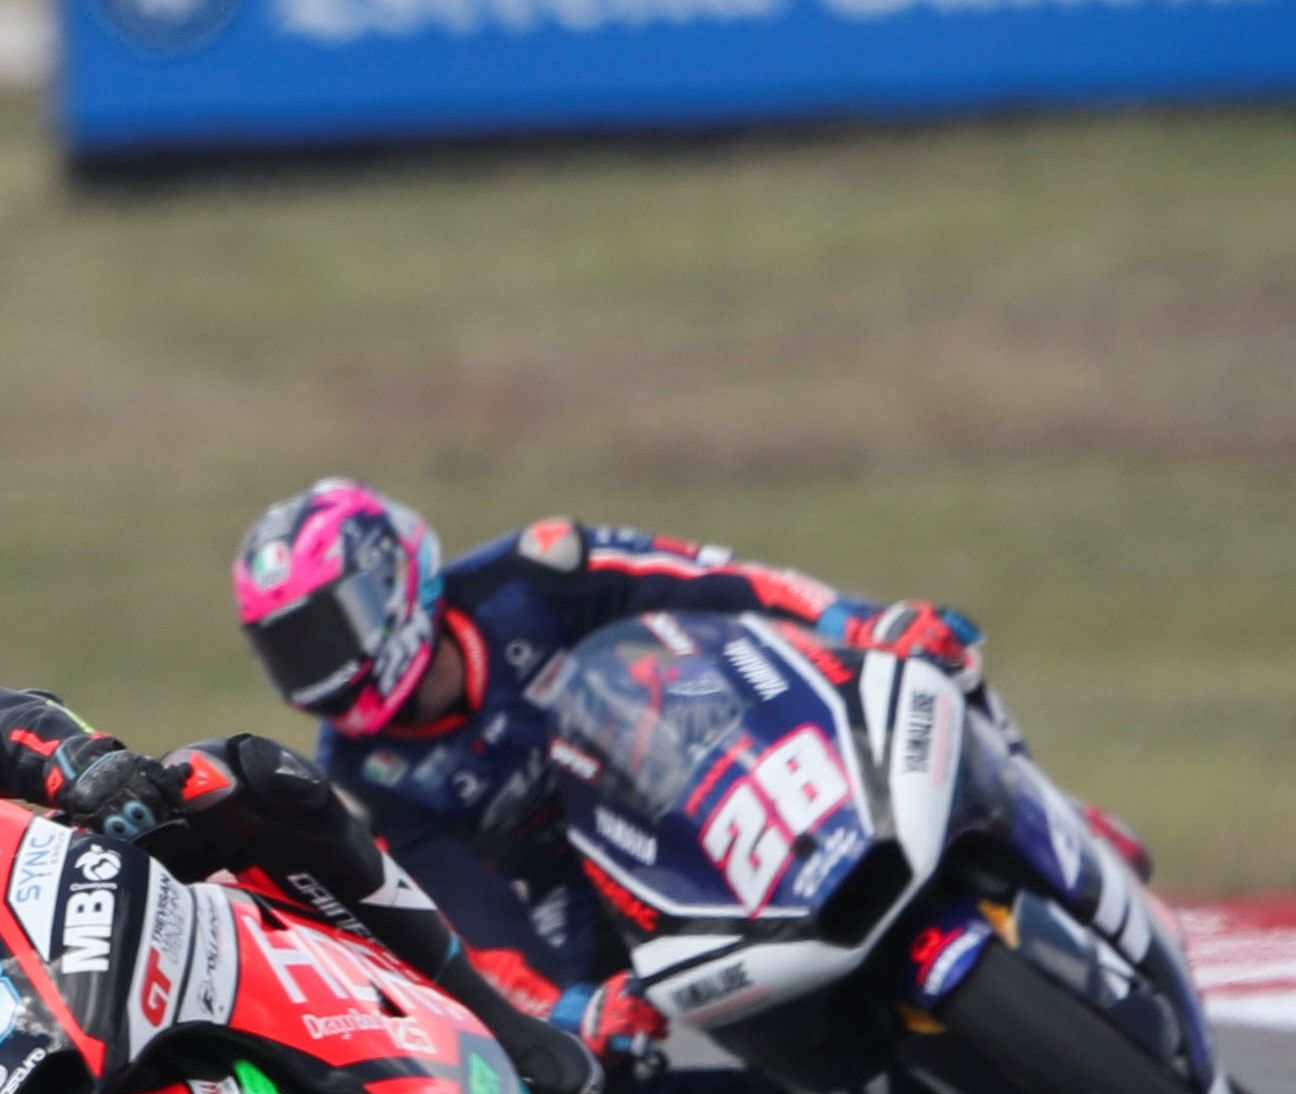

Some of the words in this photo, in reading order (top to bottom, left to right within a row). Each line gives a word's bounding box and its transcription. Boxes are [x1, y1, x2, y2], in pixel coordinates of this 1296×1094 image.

[699, 722, 854, 920] 28
[17, 832, 56, 904] SYNC
[61, 889, 116, 974] MB
